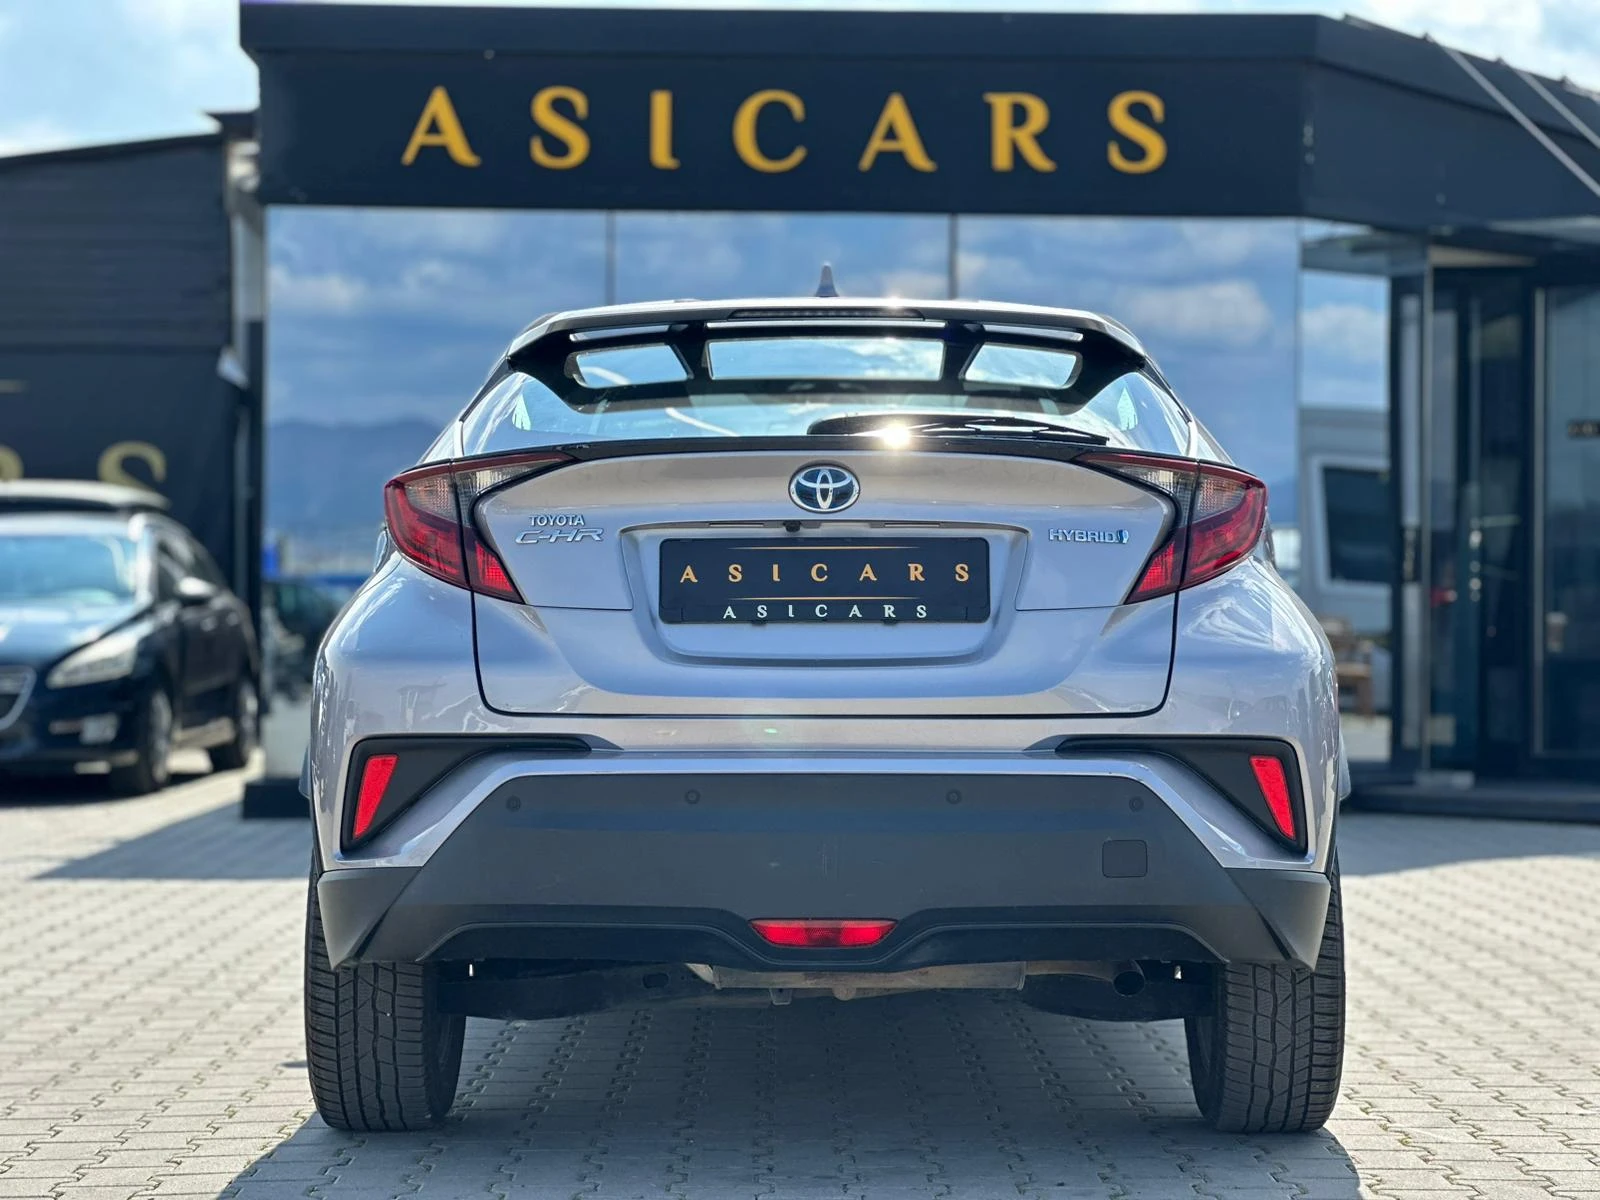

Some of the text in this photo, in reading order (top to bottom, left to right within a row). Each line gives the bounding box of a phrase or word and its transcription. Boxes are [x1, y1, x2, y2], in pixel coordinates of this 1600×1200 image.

[401, 85, 1168, 174] ASICARS
[529, 514, 585, 526] TOYOTA
[515, 528, 604, 544] C-HR
[1049, 528, 1118, 543] HYBRID
[679, 563, 971, 583] ASICARS
[722, 604, 928, 619] ASICARS
